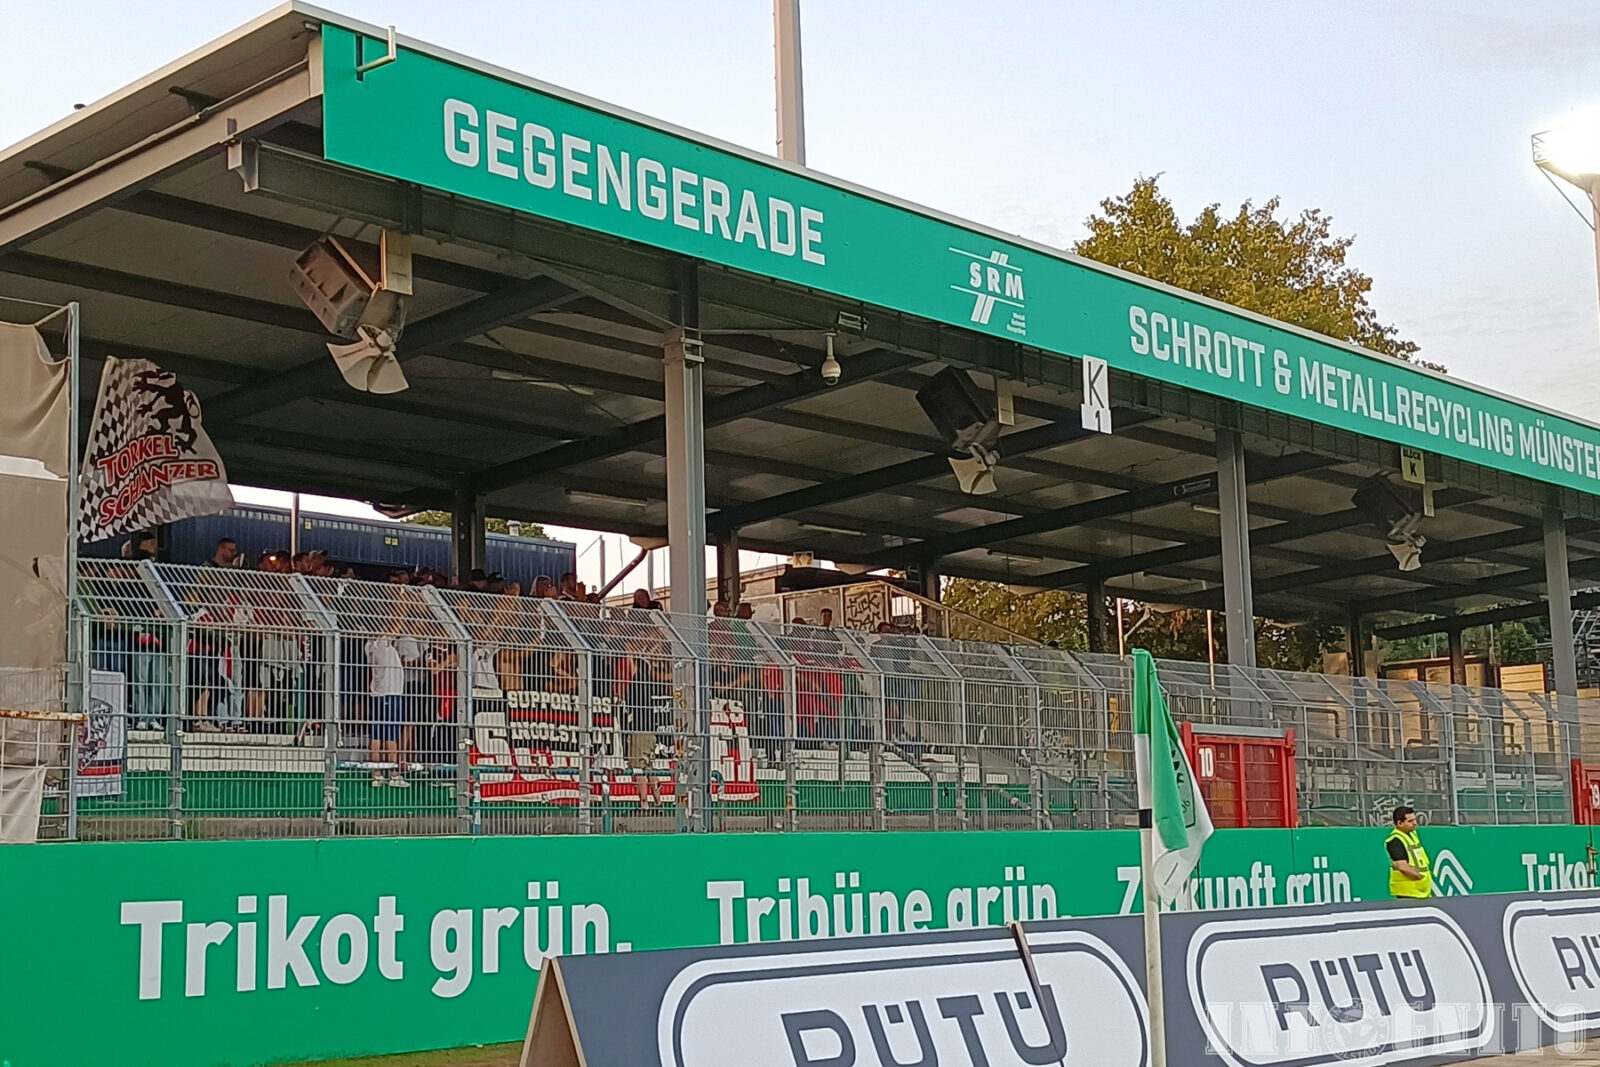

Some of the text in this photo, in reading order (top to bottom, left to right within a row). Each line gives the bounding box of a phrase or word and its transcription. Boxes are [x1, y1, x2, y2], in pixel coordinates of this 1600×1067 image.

[443, 98, 826, 265] GEGENGERADE
[969, 262, 1024, 300] SRM
[1088, 361, 1104, 408] K
[1129, 305, 1600, 480] SCHROTT & METALLRECYCLING MÜNSTE
[98, 436, 179, 486] TORKEL
[1409, 461, 1418, 478] K
[99, 462, 217, 526] SCHANZER
[510, 721, 613, 745] INGOLSTDT
[1198, 747, 1214, 778] 10
[120, 895, 404, 1000] Trikot
[706, 872, 933, 945] Tribüne
[1117, 860, 1276, 916] Zkunft
